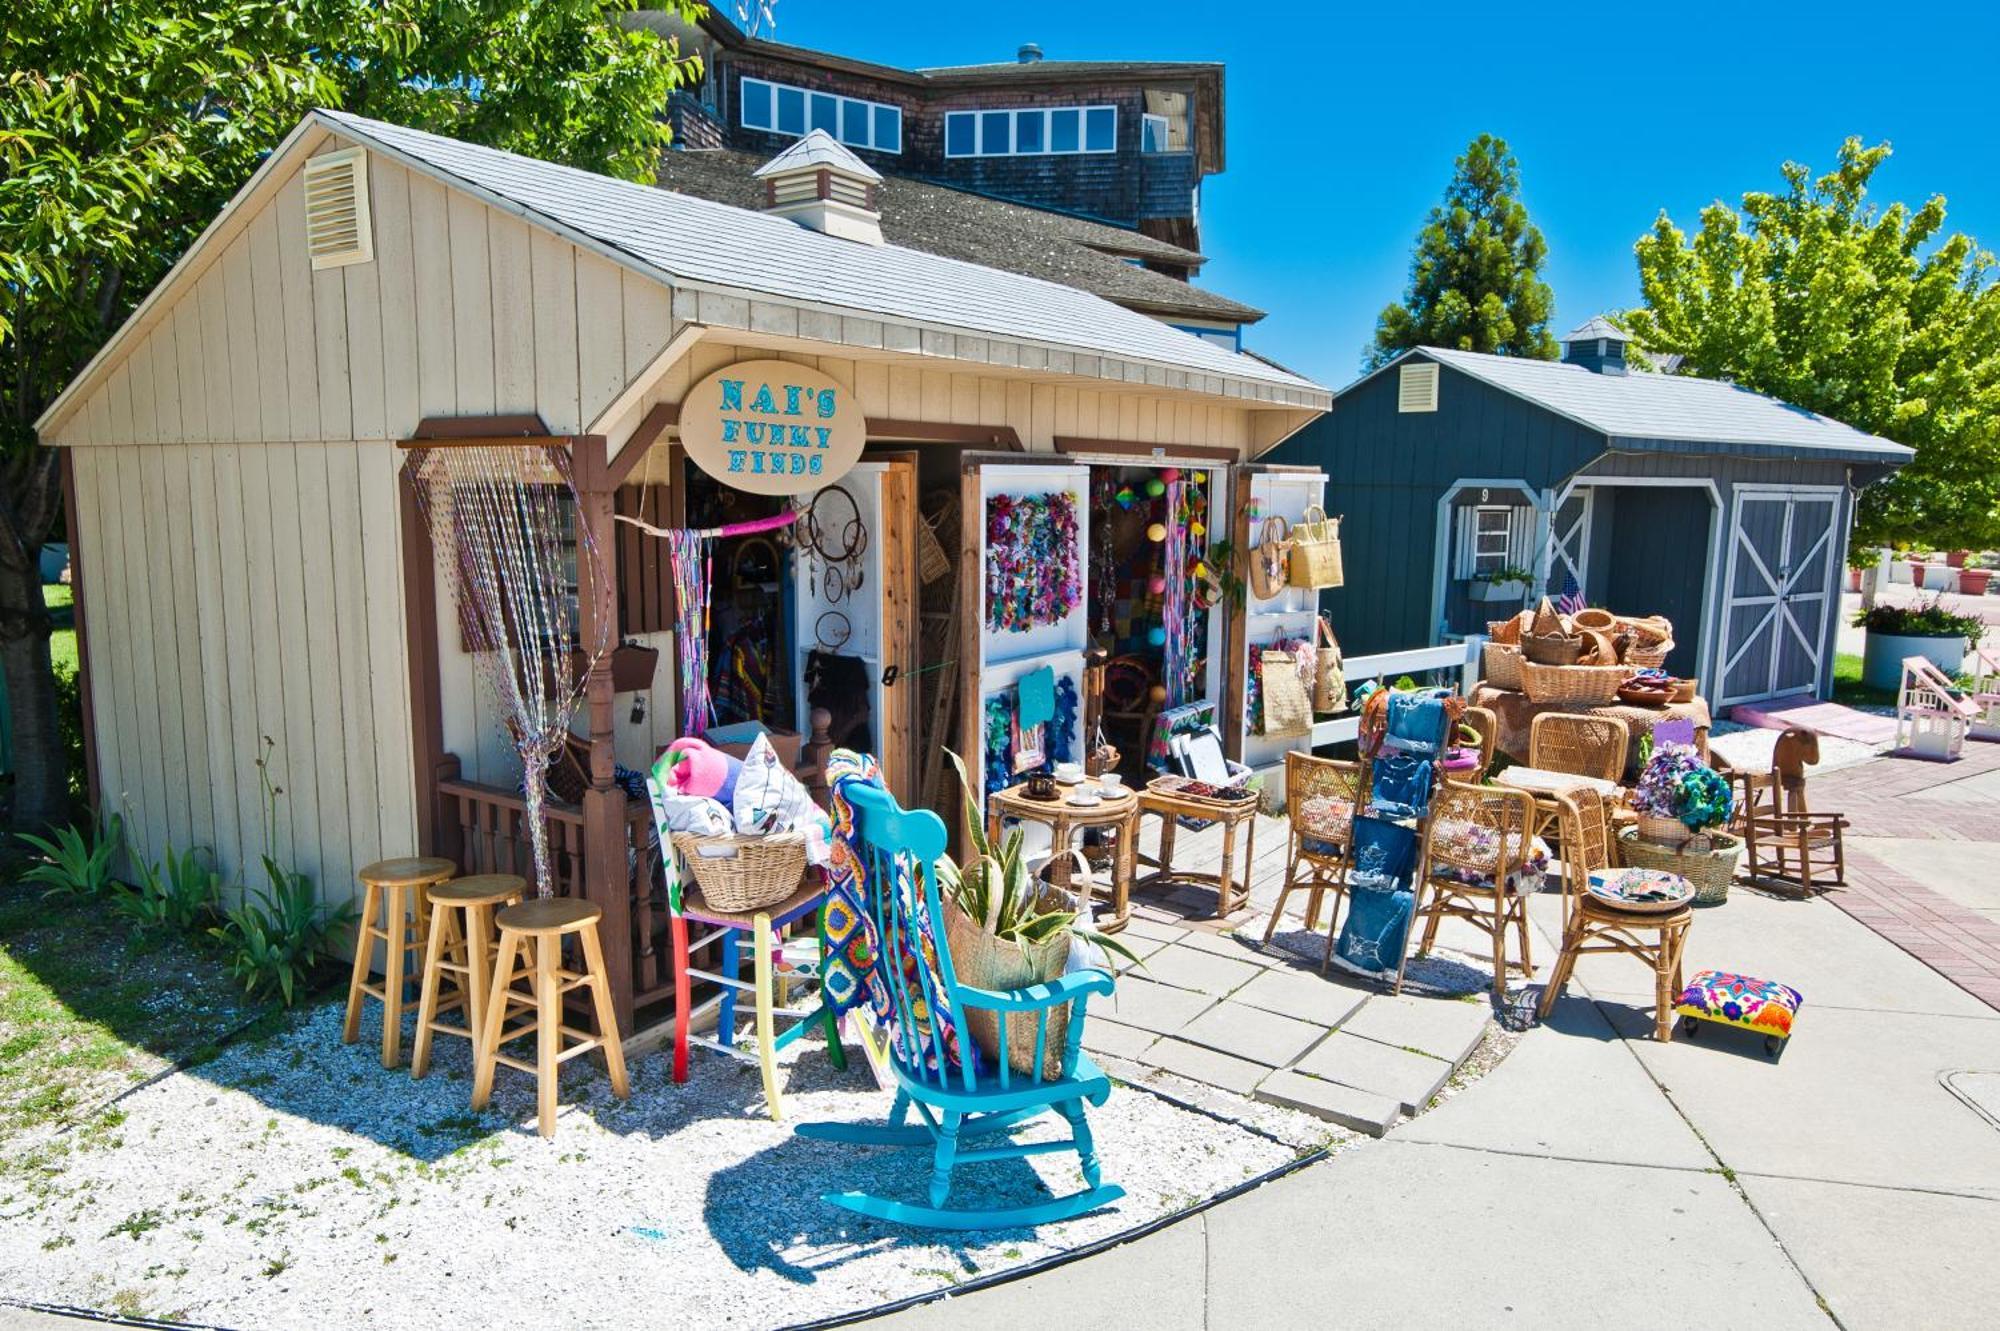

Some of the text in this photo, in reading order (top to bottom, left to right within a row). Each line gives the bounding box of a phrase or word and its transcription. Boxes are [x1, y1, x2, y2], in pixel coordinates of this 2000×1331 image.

[719, 379, 836, 418] NAI'S
[721, 419, 832, 448] FUNKY
[728, 450, 823, 475] FINDS
[1482, 488, 1489, 502] 9
